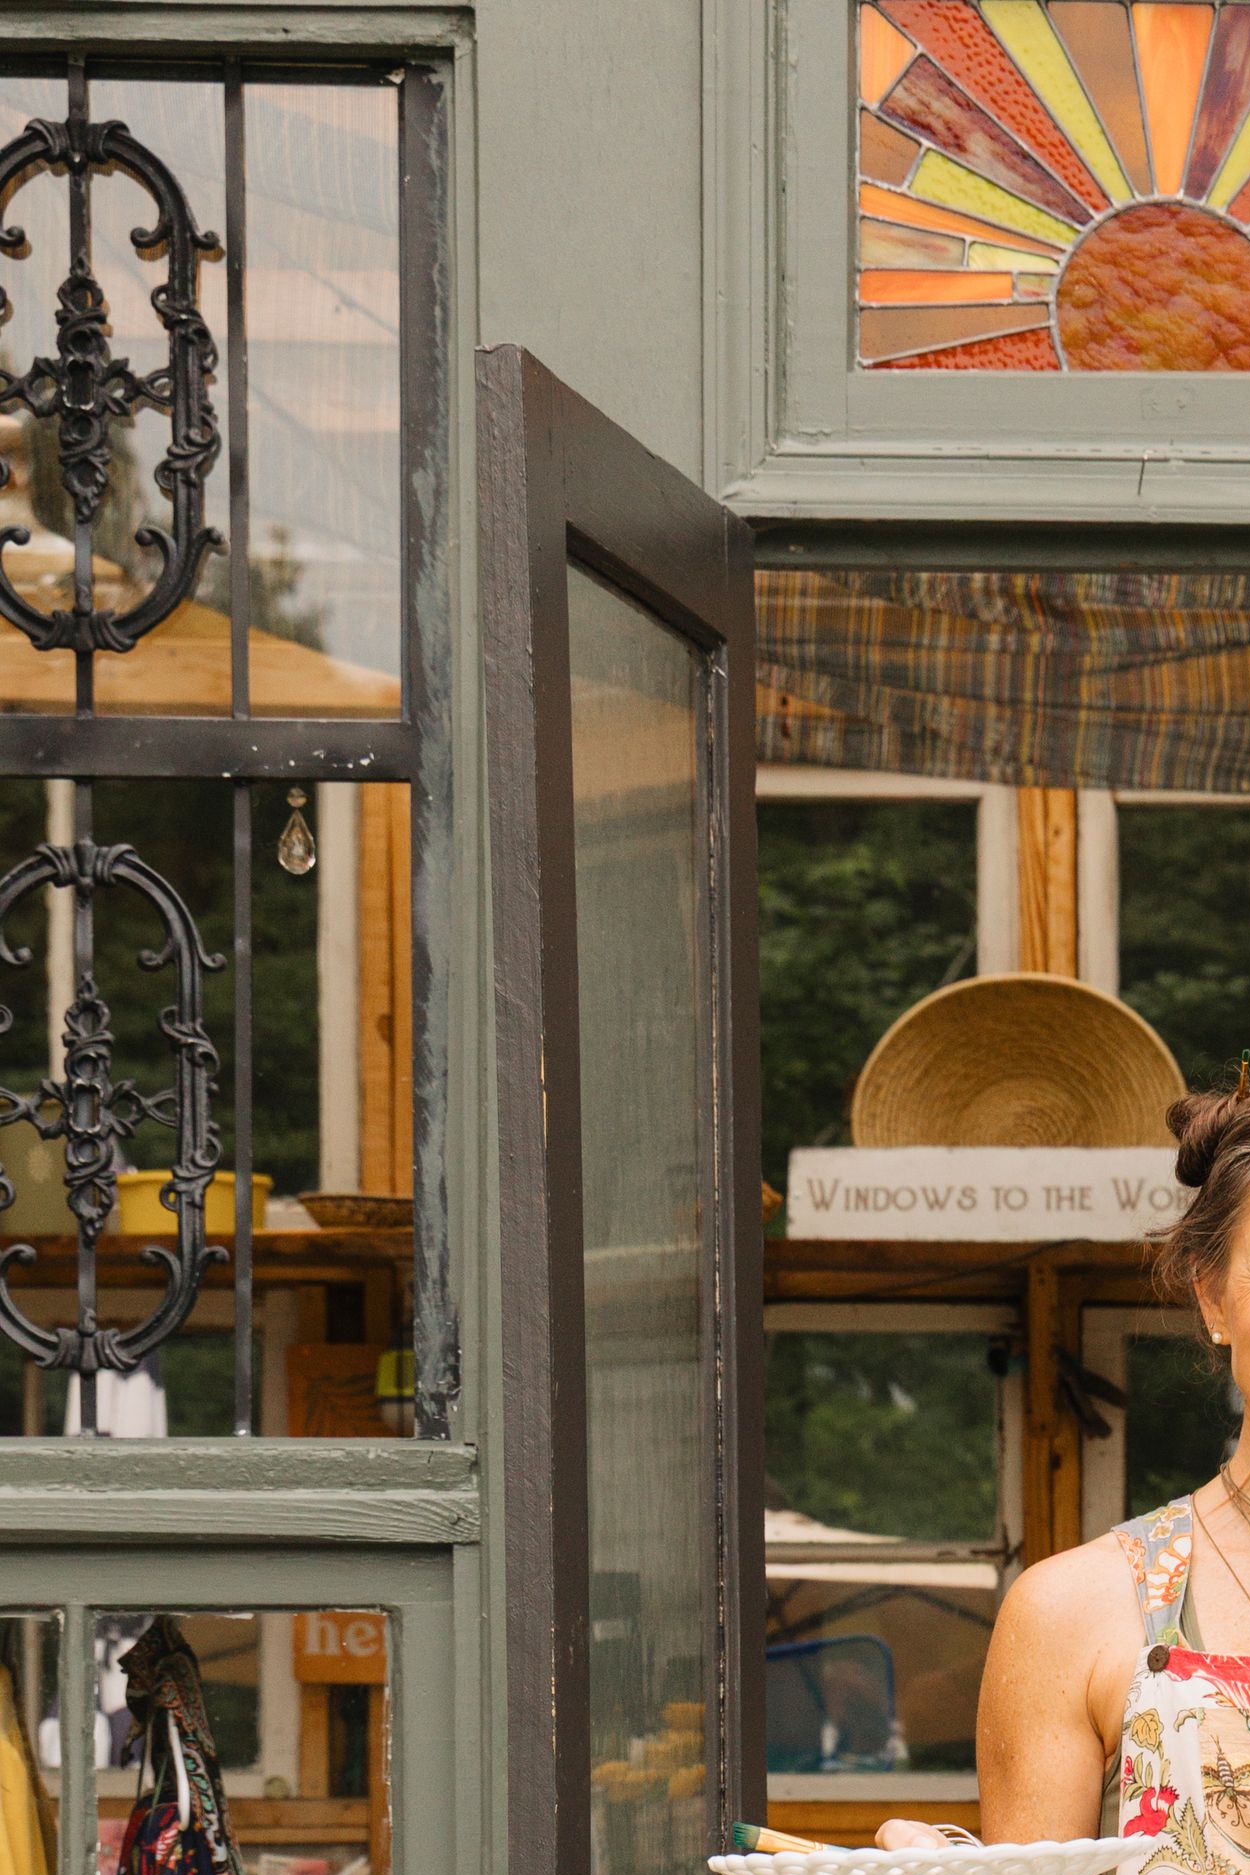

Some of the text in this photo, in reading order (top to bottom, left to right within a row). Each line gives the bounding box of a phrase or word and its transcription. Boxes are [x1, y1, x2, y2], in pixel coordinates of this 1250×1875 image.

[806, 1177, 977, 1213] WINDOWS
[991, 1184, 1029, 1213] TO
[1043, 1184, 1093, 1213] THE
